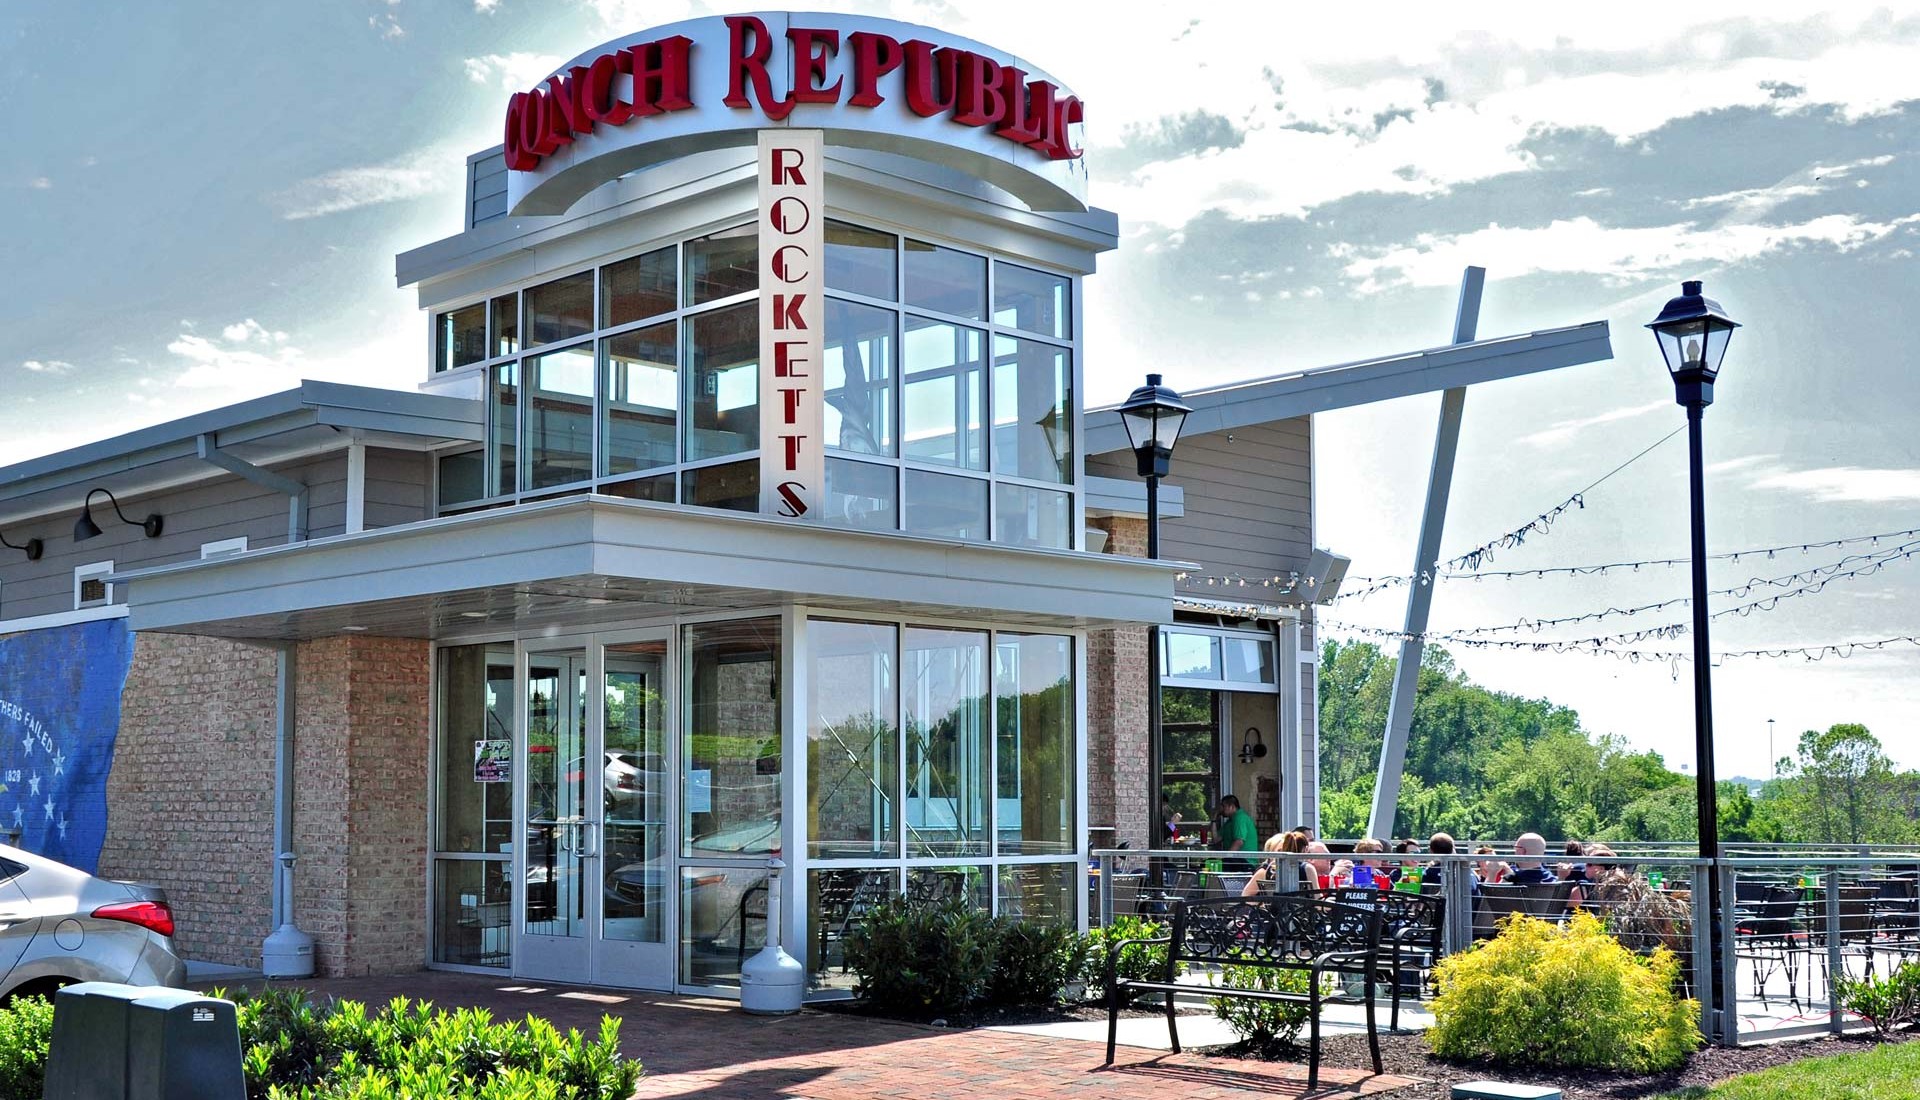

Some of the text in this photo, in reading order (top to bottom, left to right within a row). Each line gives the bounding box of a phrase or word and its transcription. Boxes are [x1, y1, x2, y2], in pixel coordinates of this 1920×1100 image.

[504, 16, 1084, 172] CONCH REPUBLIC
[770, 147, 810, 518] ROCKETTS
[0, 700, 53, 753] HERS FAILED
[5, 769, 21, 783] 1828
